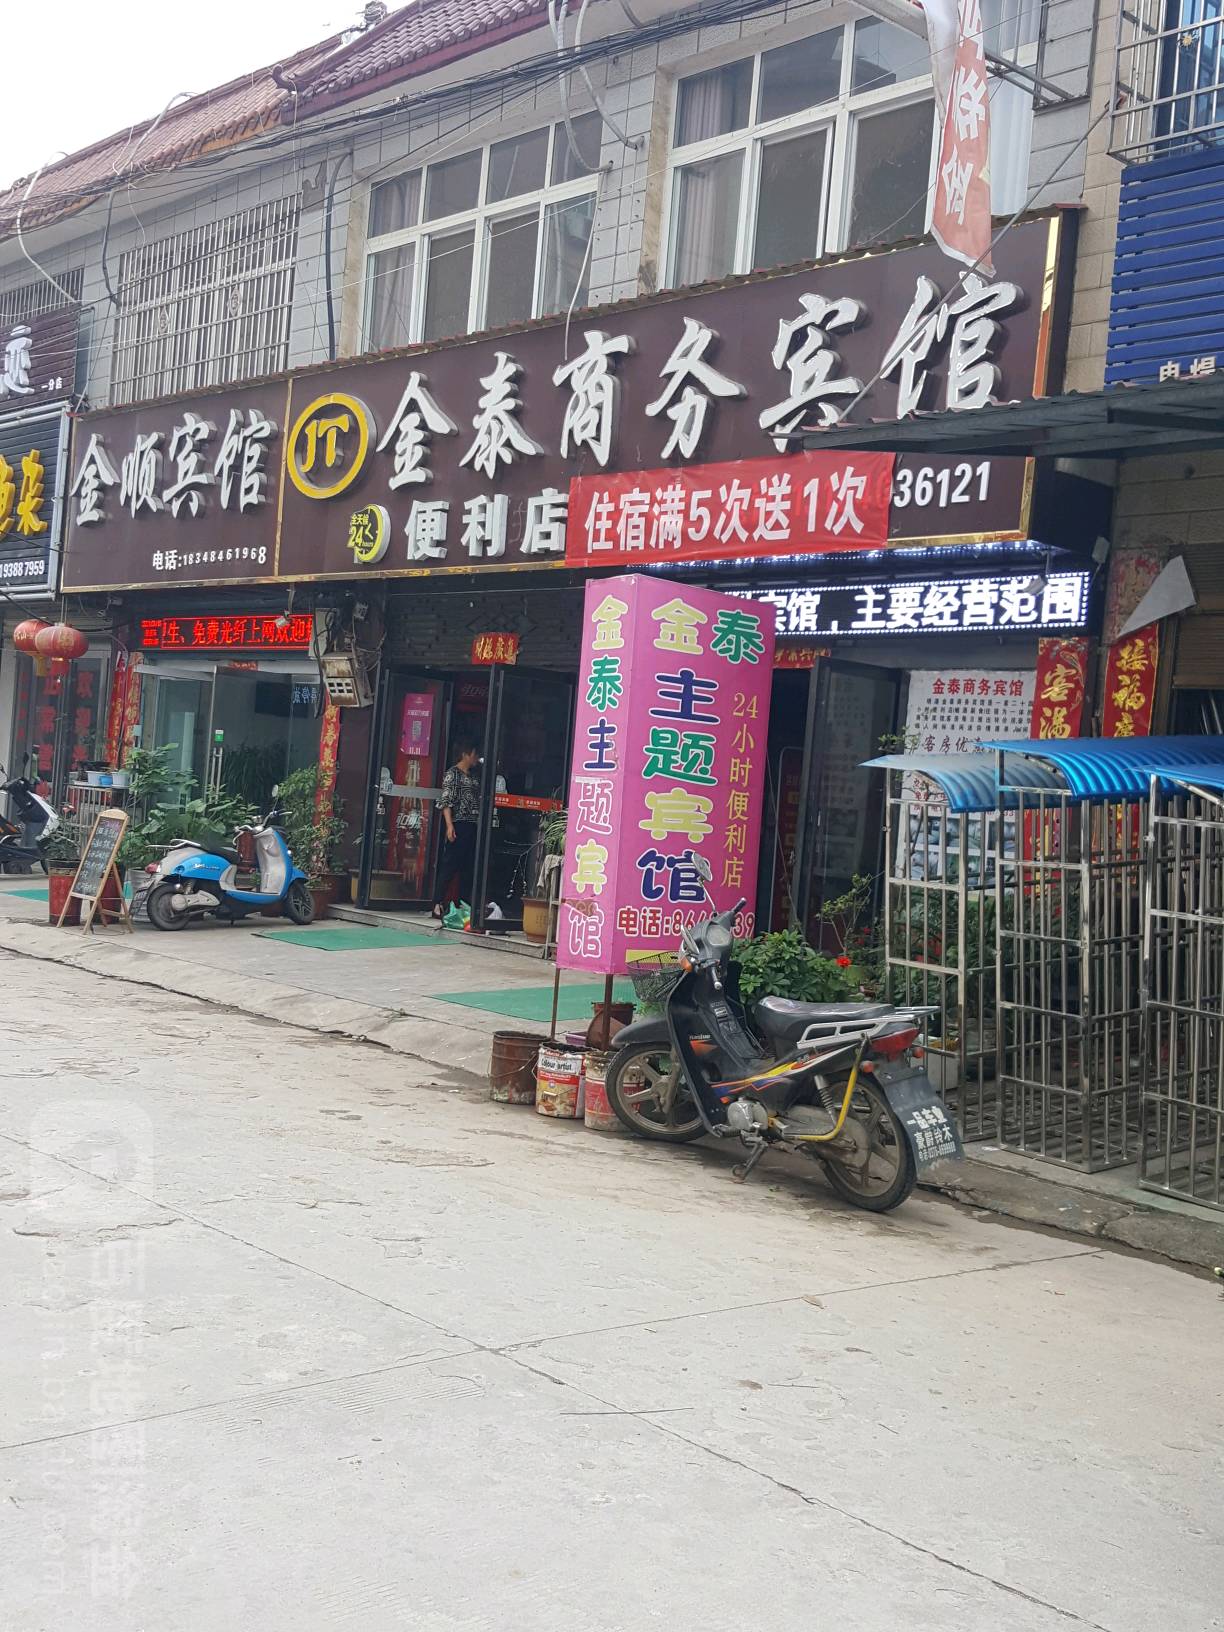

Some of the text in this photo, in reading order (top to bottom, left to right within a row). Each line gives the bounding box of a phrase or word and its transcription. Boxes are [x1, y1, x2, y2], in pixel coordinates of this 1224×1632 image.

[377, 271, 1024, 490] 金泰商务宾馆
[70, 408, 277, 526] 金顺宾馆
[404, 487, 569, 561] 便利店
[585, 465, 868, 554] 住宿满5次送1次
[650, 597, 765, 665] 金泰
[932, 678, 1024, 697] 金泰商务宾馆
[568, 594, 629, 958] 金泰主题宾馆
[637, 667, 721, 904] 主题宾馆
[720, 691, 759, 889] 24小时便利店
